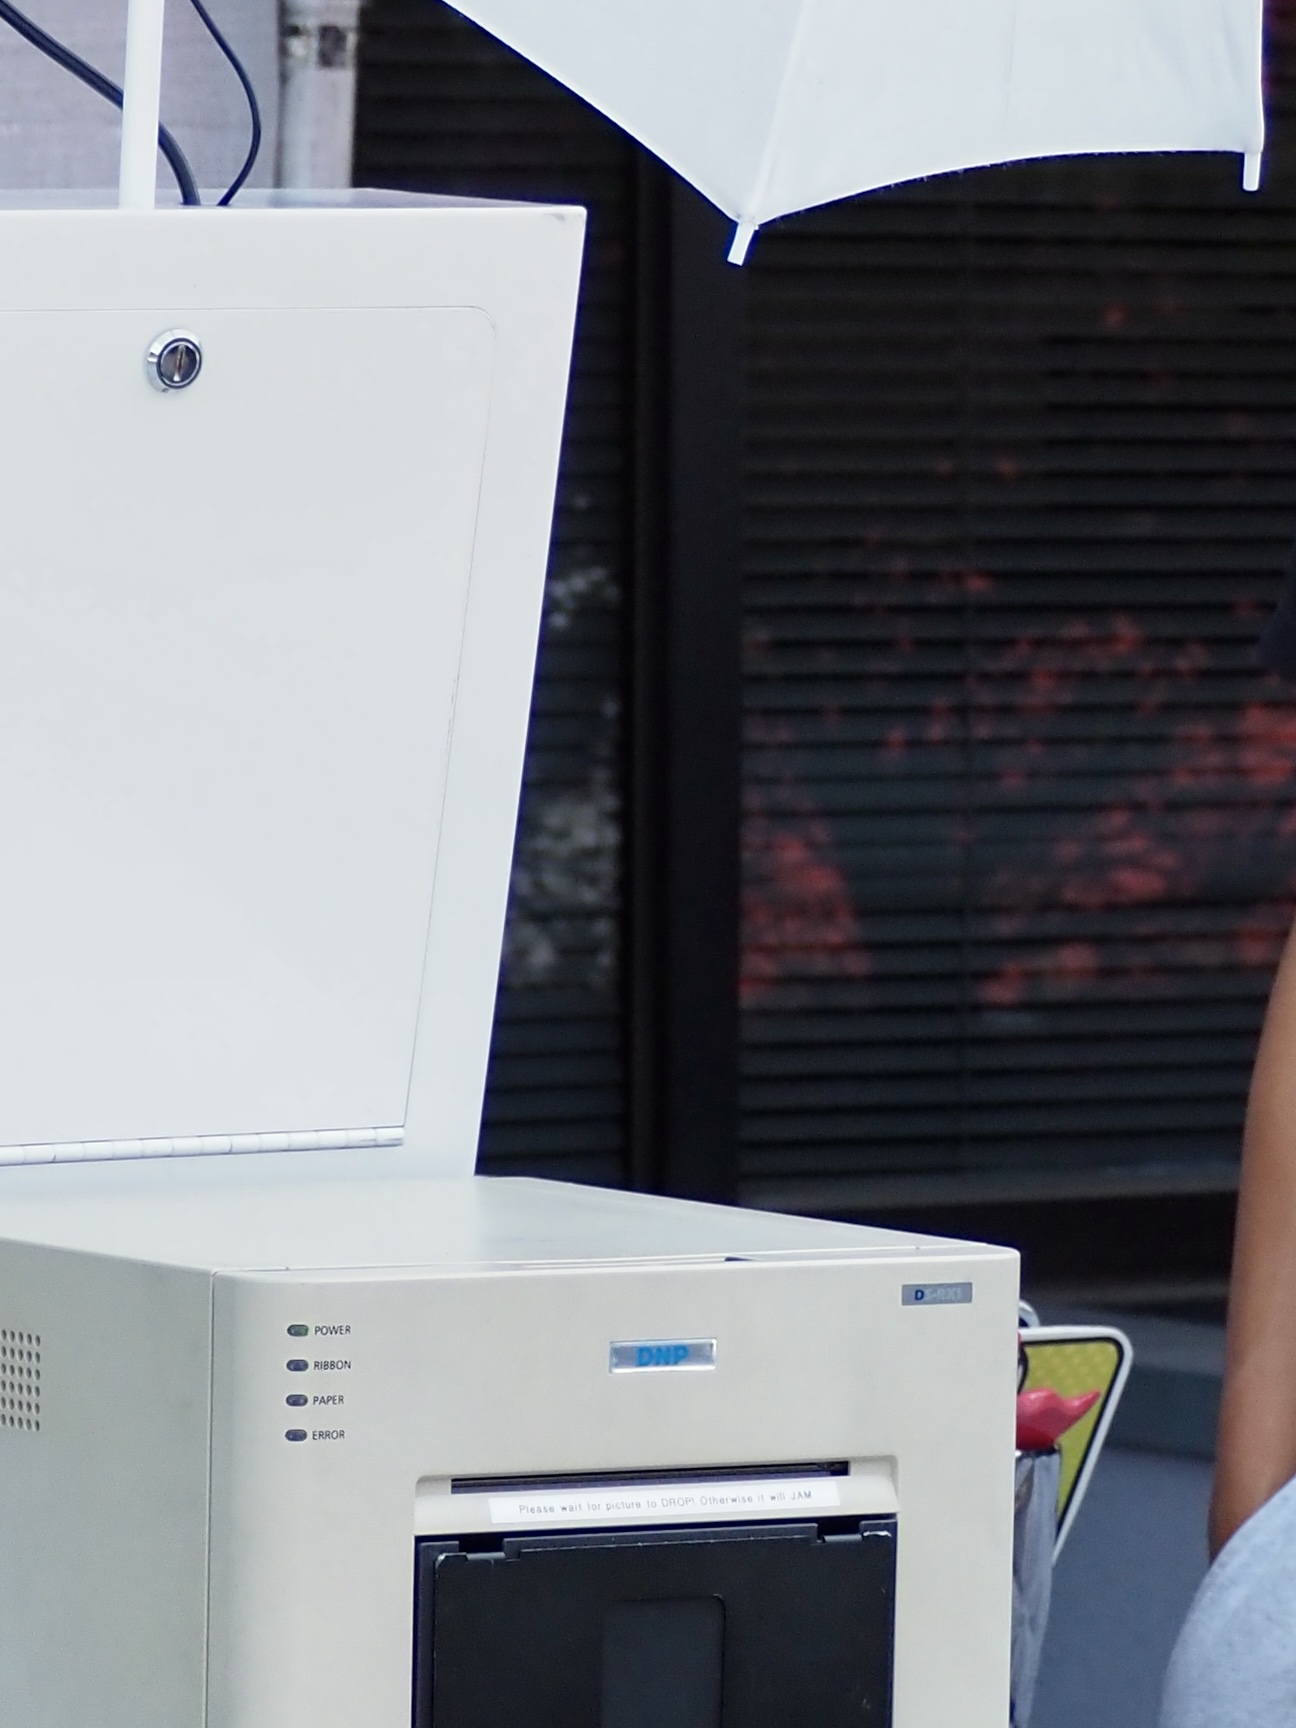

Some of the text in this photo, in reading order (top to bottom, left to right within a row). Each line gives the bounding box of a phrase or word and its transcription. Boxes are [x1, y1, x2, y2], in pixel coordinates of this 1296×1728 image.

[314, 1325, 351, 1336] POWER
[635, 1344, 690, 1367] DNP
[313, 1360, 352, 1371] RIBBON
[312, 1395, 345, 1406] PAPER
[311, 1430, 346, 1441] ERROR
[518, 1504, 555, 1514] Please
[560, 1502, 583, 1512] wait
[587, 1501, 601, 1511] for
[606, 1500, 642, 1512] picture
[647, 1499, 657, 1509] to
[700, 1495, 753, 1506] Otherwise
[757, 1493, 765, 1503] it
[770, 1492, 786, 1502] will
[791, 1490, 813, 1501] JAM
